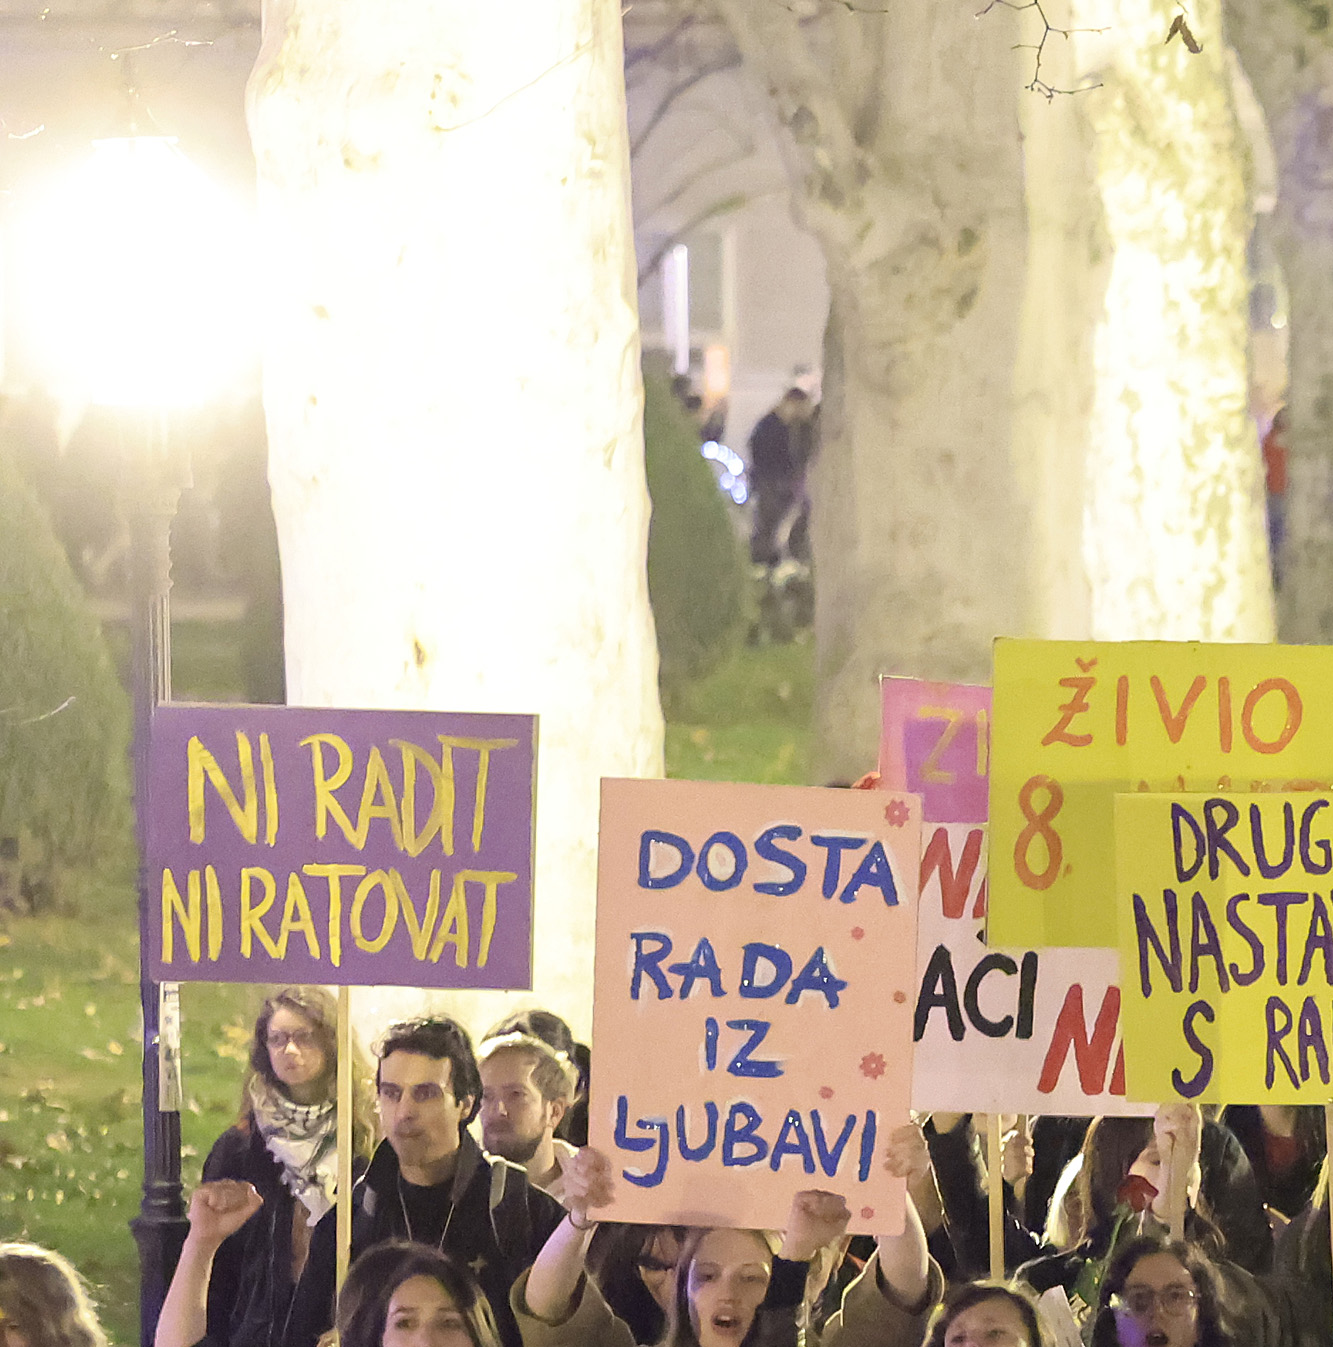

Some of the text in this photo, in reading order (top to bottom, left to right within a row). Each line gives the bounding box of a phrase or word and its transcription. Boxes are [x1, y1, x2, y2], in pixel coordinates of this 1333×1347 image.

[1041, 657, 1303, 754] ŽIVIO
[186, 730, 519, 857] NI RADIT
[638, 825, 899, 906] DOSTA
[161, 862, 518, 967] NI RATOVAT
[630, 931, 847, 1008] RADA
[705, 1018, 786, 1078] IZ
[1171, 999, 1215, 1098] S
[612, 1095, 877, 1187] LJUBAVI
